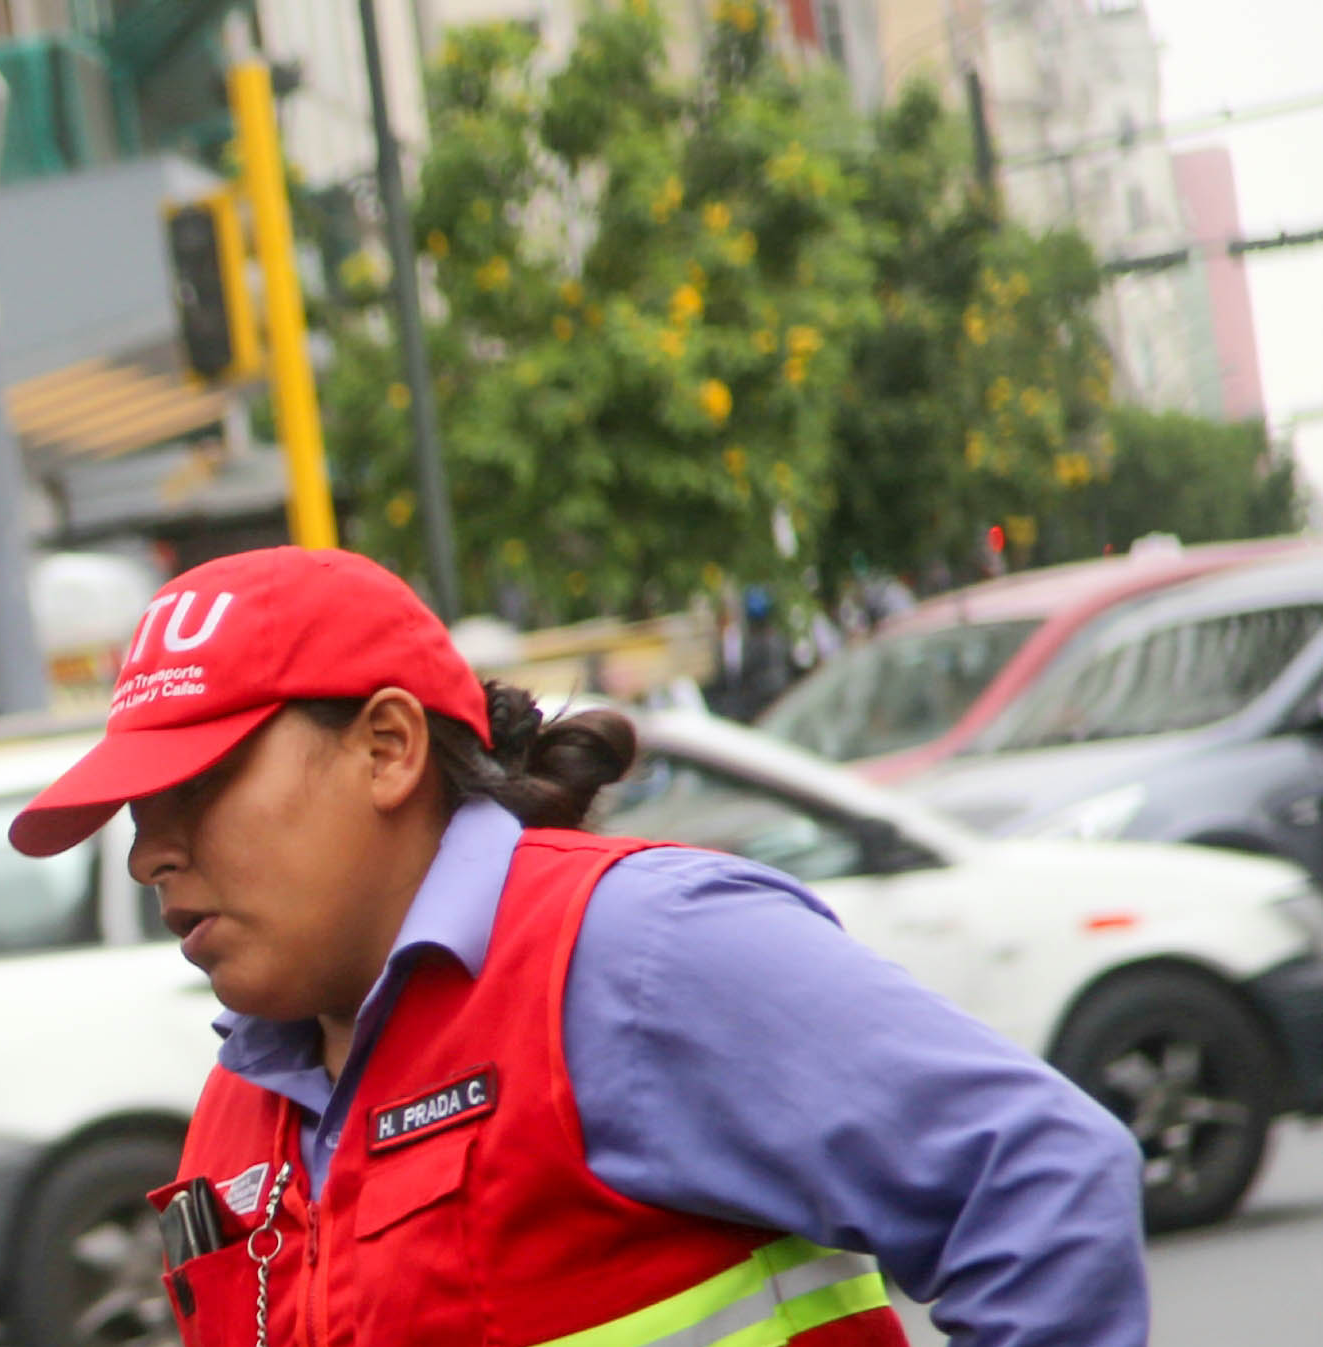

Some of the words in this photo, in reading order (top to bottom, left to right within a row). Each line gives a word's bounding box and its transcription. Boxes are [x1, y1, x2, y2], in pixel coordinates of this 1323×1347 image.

[121, 590, 234, 667] TU
[161, 681, 205, 697] Callao
[379, 1114, 395, 1139] H.
[402, 1089, 462, 1132] PRADA
[467, 1080, 486, 1105] C.
